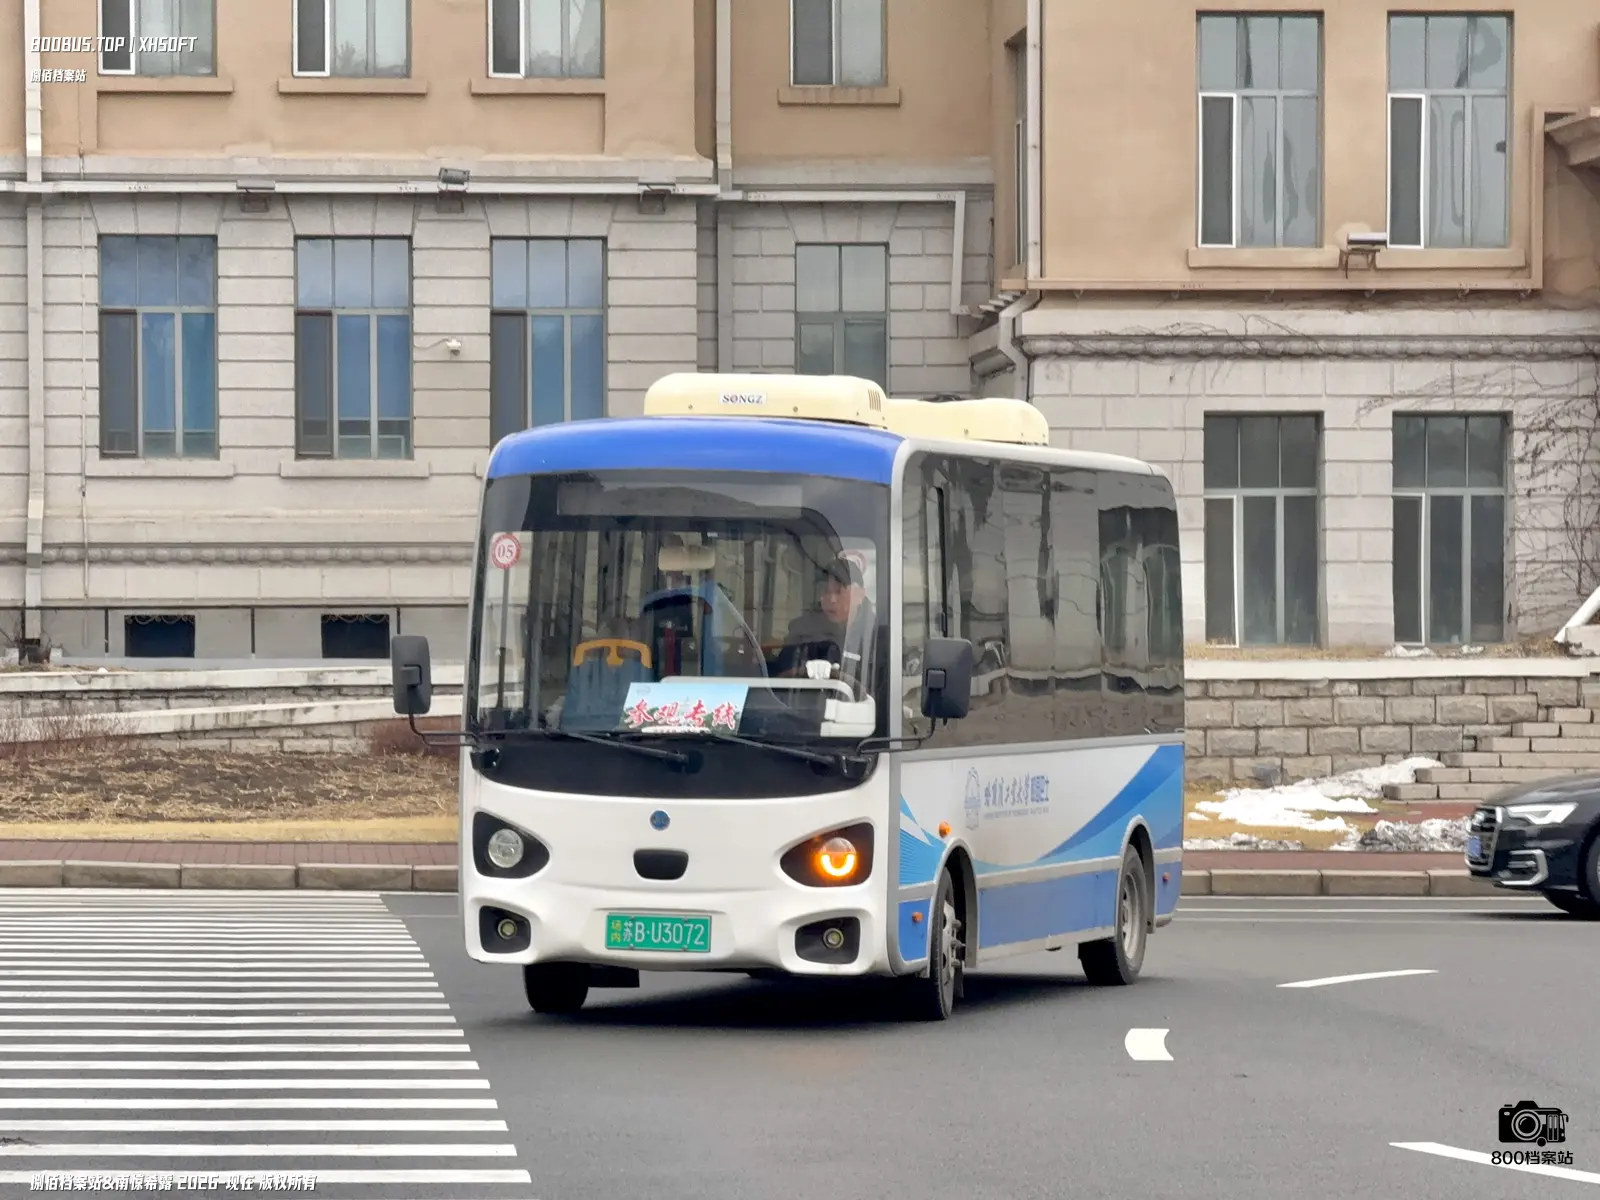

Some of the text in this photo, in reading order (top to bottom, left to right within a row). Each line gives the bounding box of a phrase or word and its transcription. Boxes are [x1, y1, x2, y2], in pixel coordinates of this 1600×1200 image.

[722, 394, 763, 404] SONGZ
[497, 544, 514, 559] 05
[624, 699, 737, 730] 参观专线
